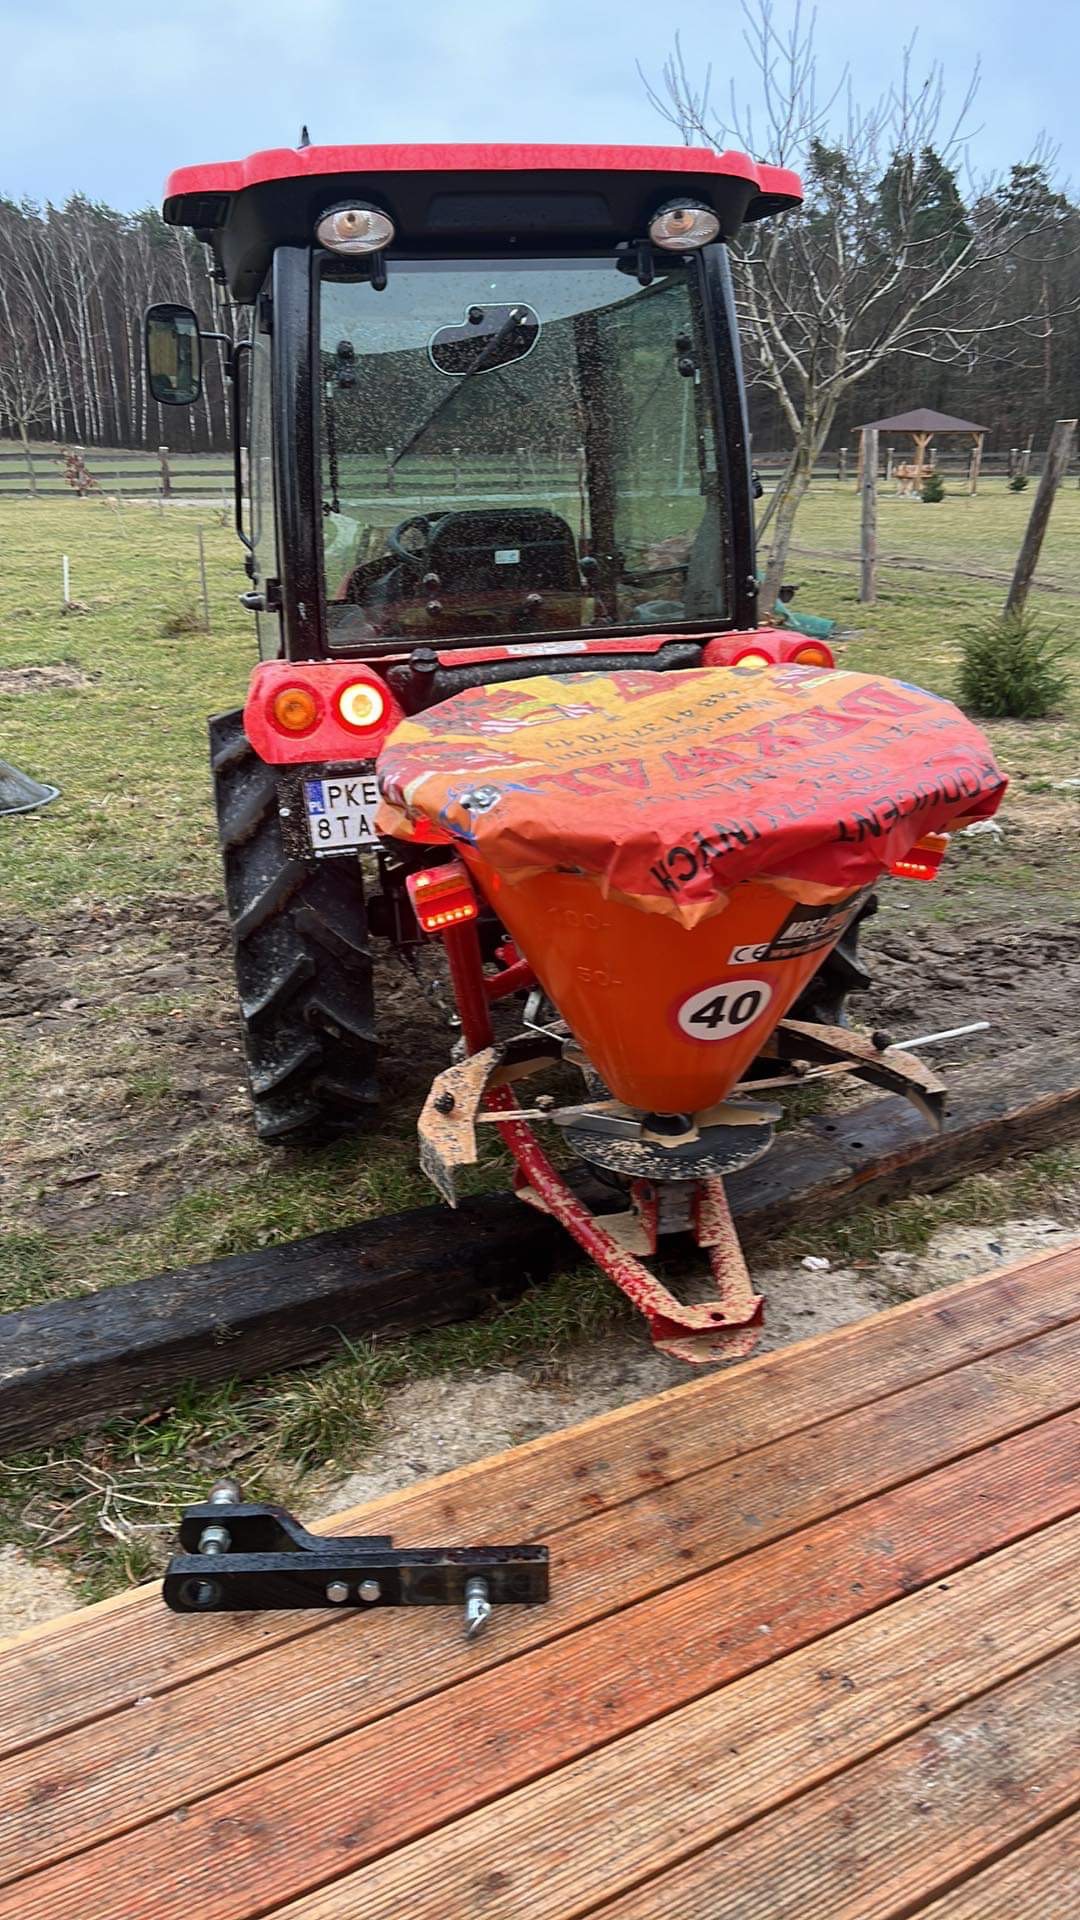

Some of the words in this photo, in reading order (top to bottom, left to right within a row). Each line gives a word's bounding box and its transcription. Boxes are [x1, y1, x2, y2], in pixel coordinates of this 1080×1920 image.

[517, 682, 929, 797] DEXWAL
[328, 783, 377, 808] PKE
[838, 763, 1004, 842] RODUCENT
[319, 815, 372, 840] 8TA
[689, 990, 761, 1029] 40
